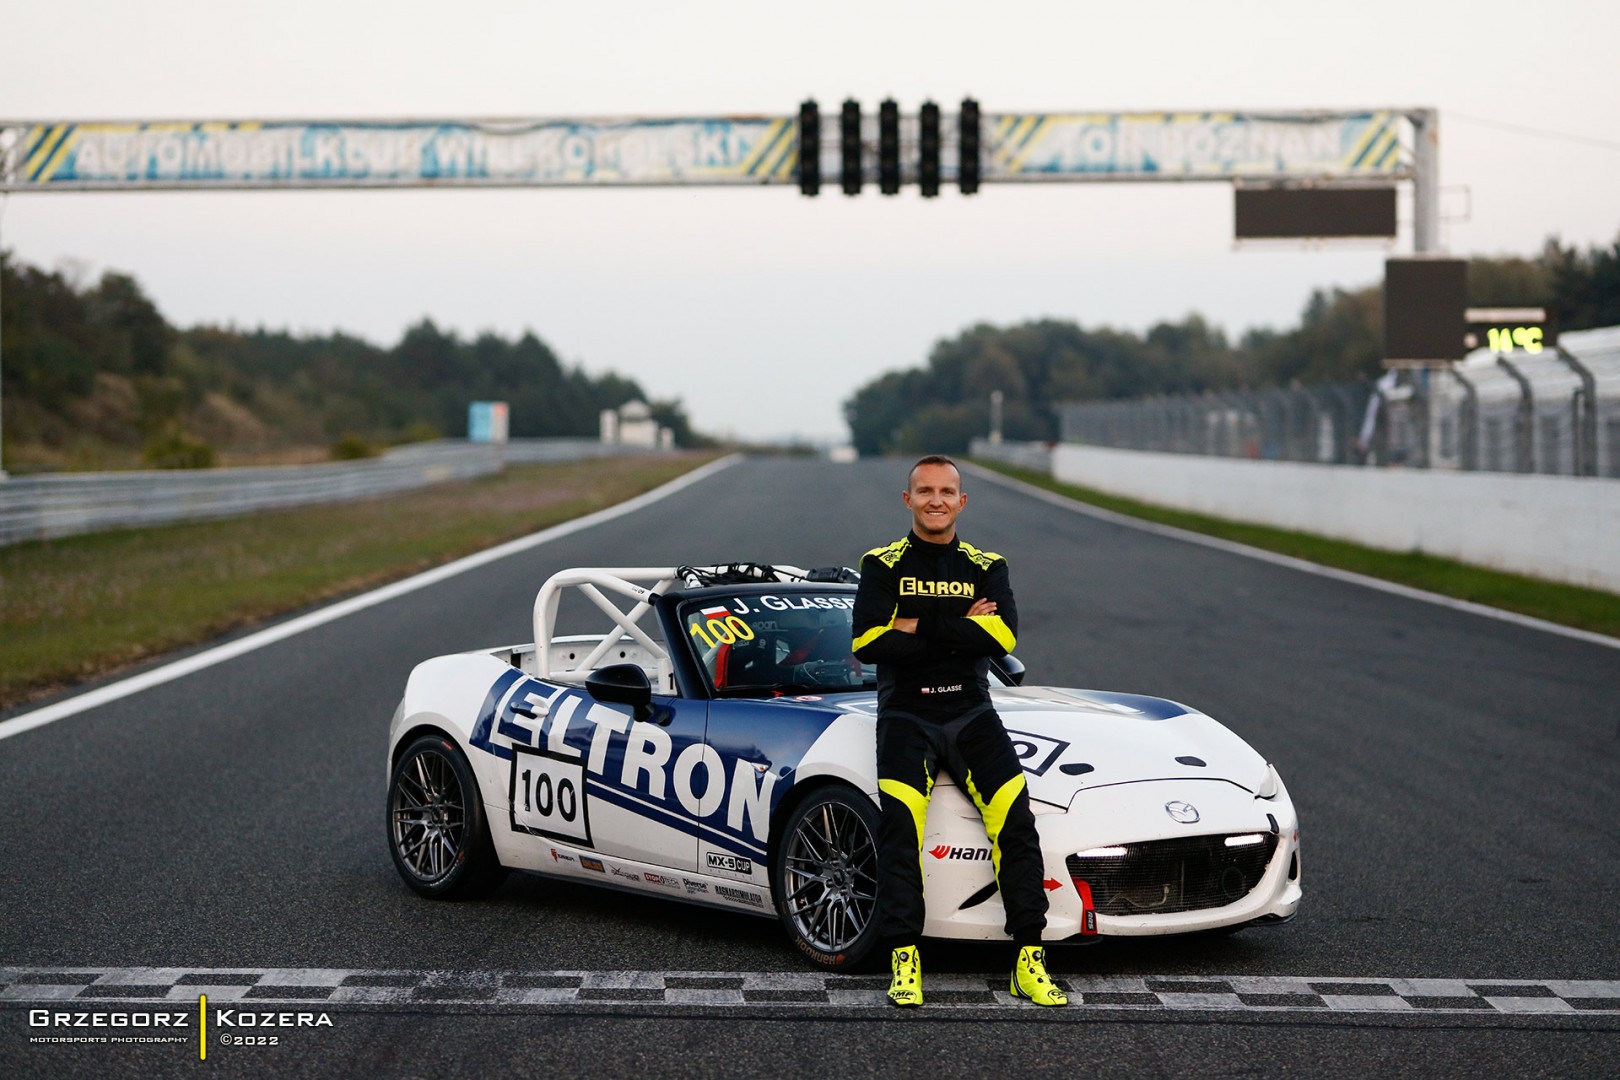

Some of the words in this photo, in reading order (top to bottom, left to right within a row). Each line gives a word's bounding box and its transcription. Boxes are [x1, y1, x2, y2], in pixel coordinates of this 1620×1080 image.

[900, 576, 975, 599] ELTRON
[689, 615, 755, 649] 100
[937, 684, 963, 693] GLASSE
[489, 674, 778, 845] ELTRON
[521, 768, 577, 823] 100
[707, 854, 735, 869] MX-5
[736, 860, 751, 873] CUP
